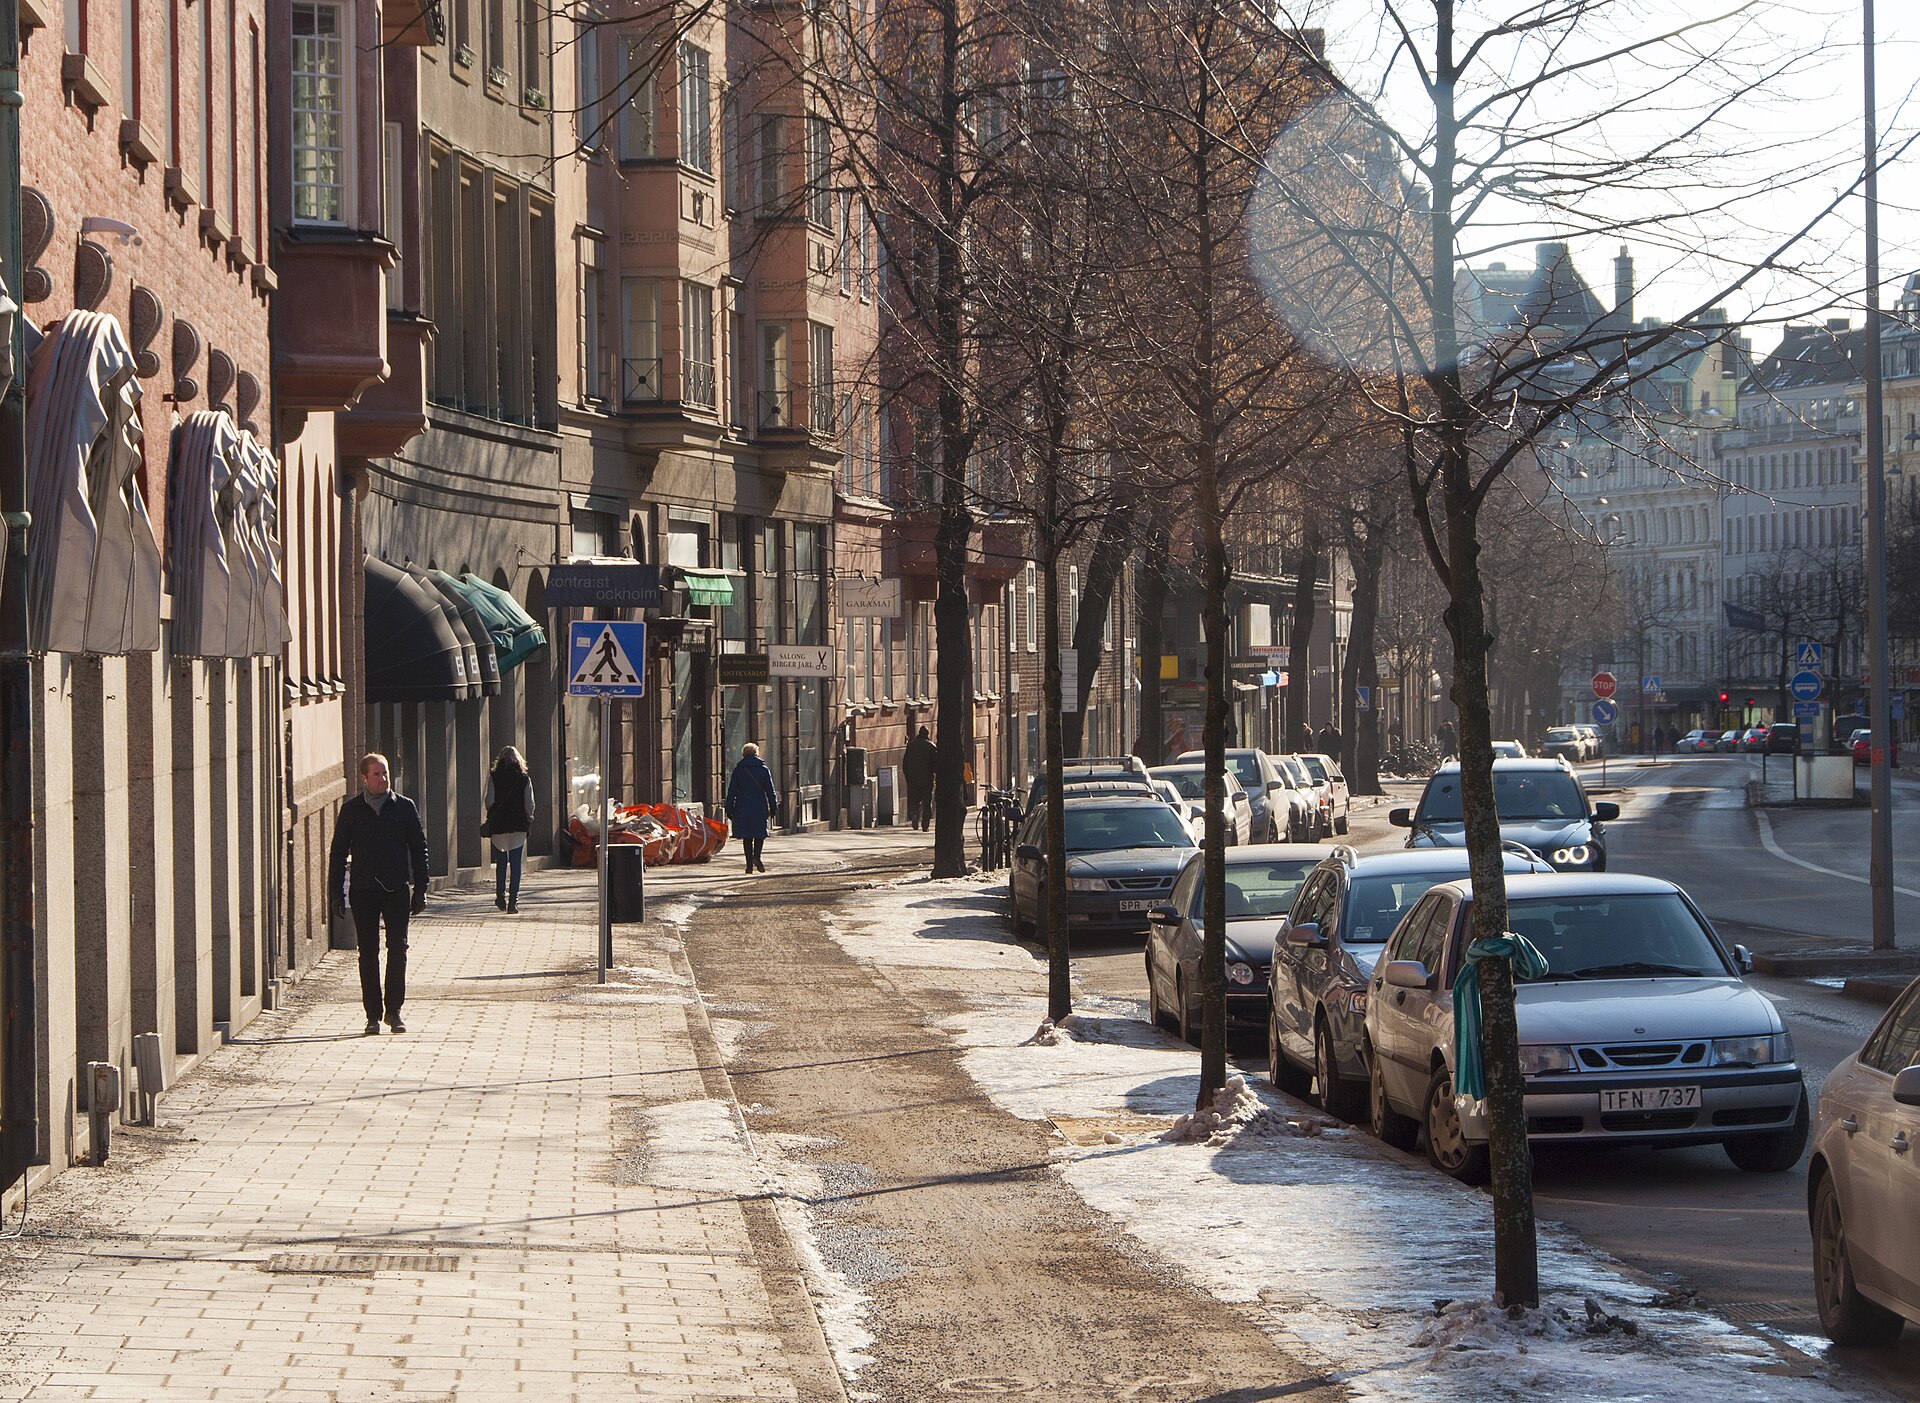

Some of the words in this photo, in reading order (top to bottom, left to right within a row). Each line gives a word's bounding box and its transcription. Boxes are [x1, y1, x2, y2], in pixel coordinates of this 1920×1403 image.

[596, 588, 657, 600] ockholm
[846, 600, 891, 608] GARAMAJ
[797, 661, 814, 670] JARL
[1594, 681, 1614, 689] STOP
[1121, 901, 1140, 910] SPR
[1147, 900, 1163, 909] 43
[1605, 1089, 1644, 1109] TFN
[1659, 1087, 1697, 1107] 737
